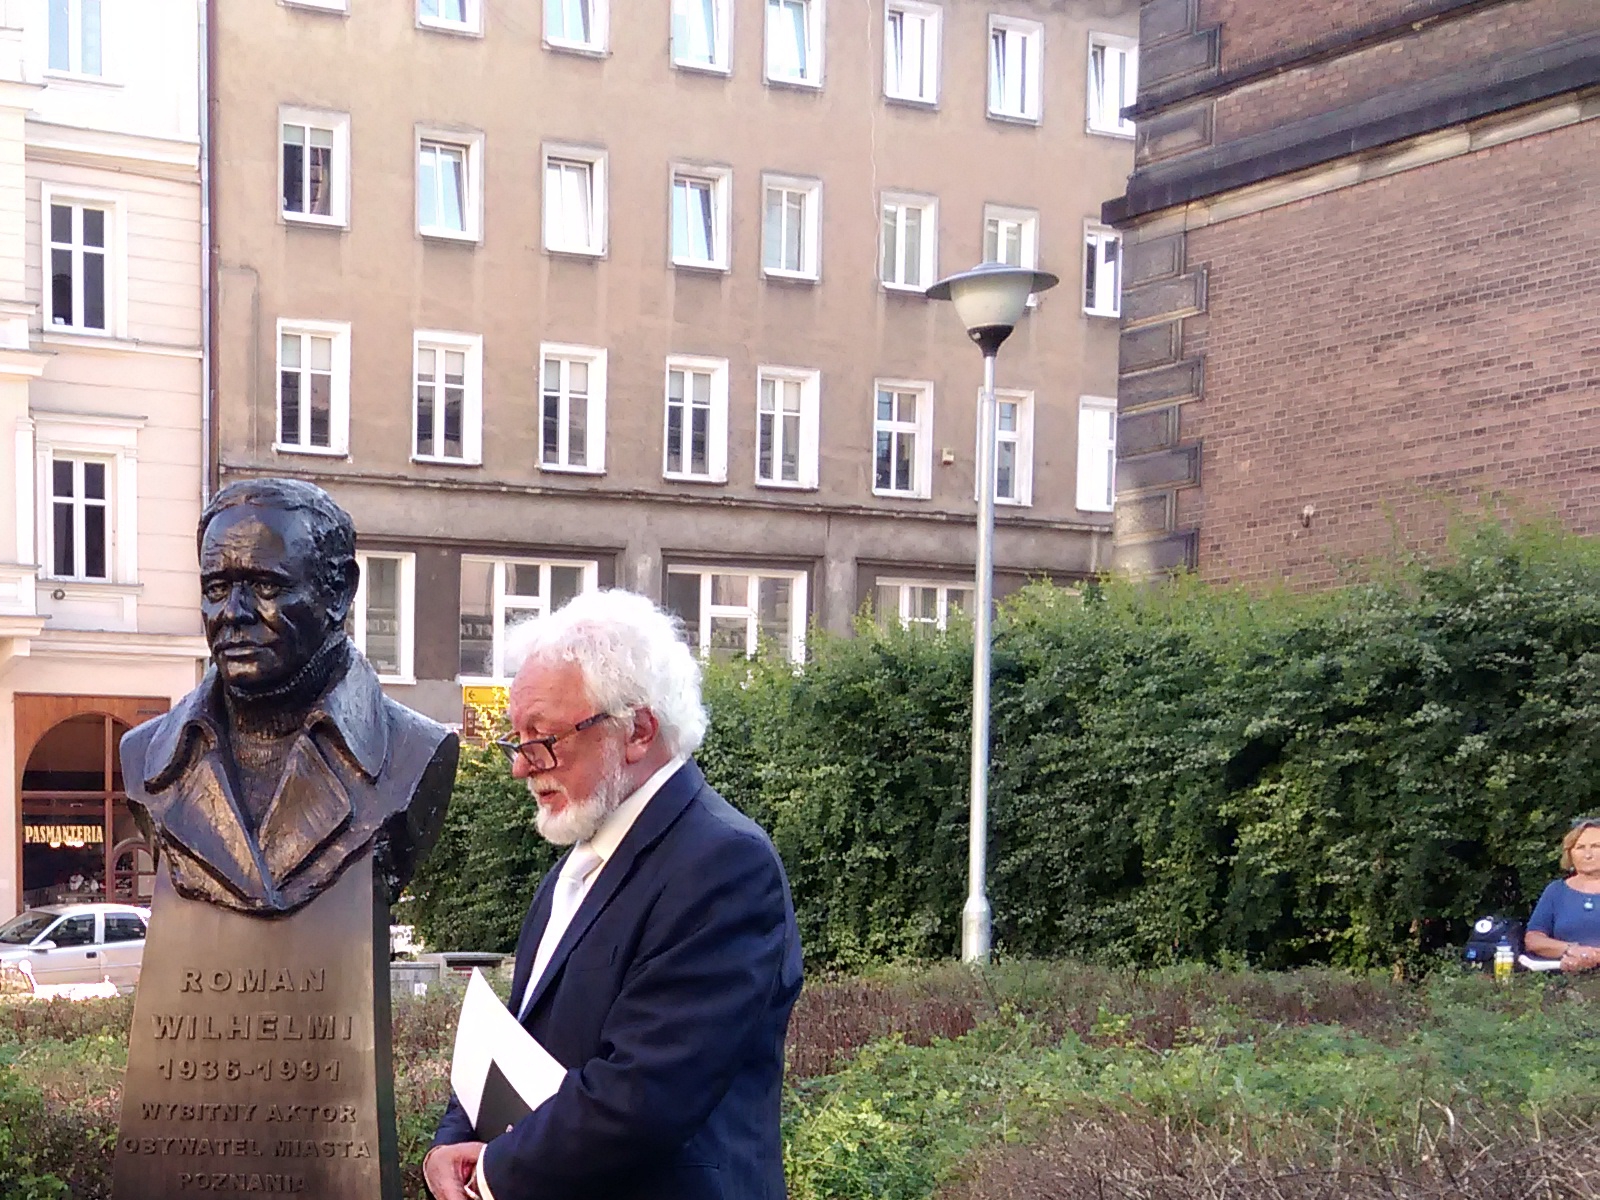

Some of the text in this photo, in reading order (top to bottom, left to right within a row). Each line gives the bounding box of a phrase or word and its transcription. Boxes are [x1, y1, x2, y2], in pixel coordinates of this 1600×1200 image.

[24, 825, 104, 843] PASMANTERIA
[179, 967, 326, 993] ROMAN
[152, 1014, 353, 1041] WILHELMI
[158, 1058, 341, 1082] 1936-1991
[141, 1103, 356, 1123] WYBITNY AKTOR
[122, 1138, 372, 1159] OBYWATEL MIASTA
[179, 1173, 311, 1194] POZNANIA
